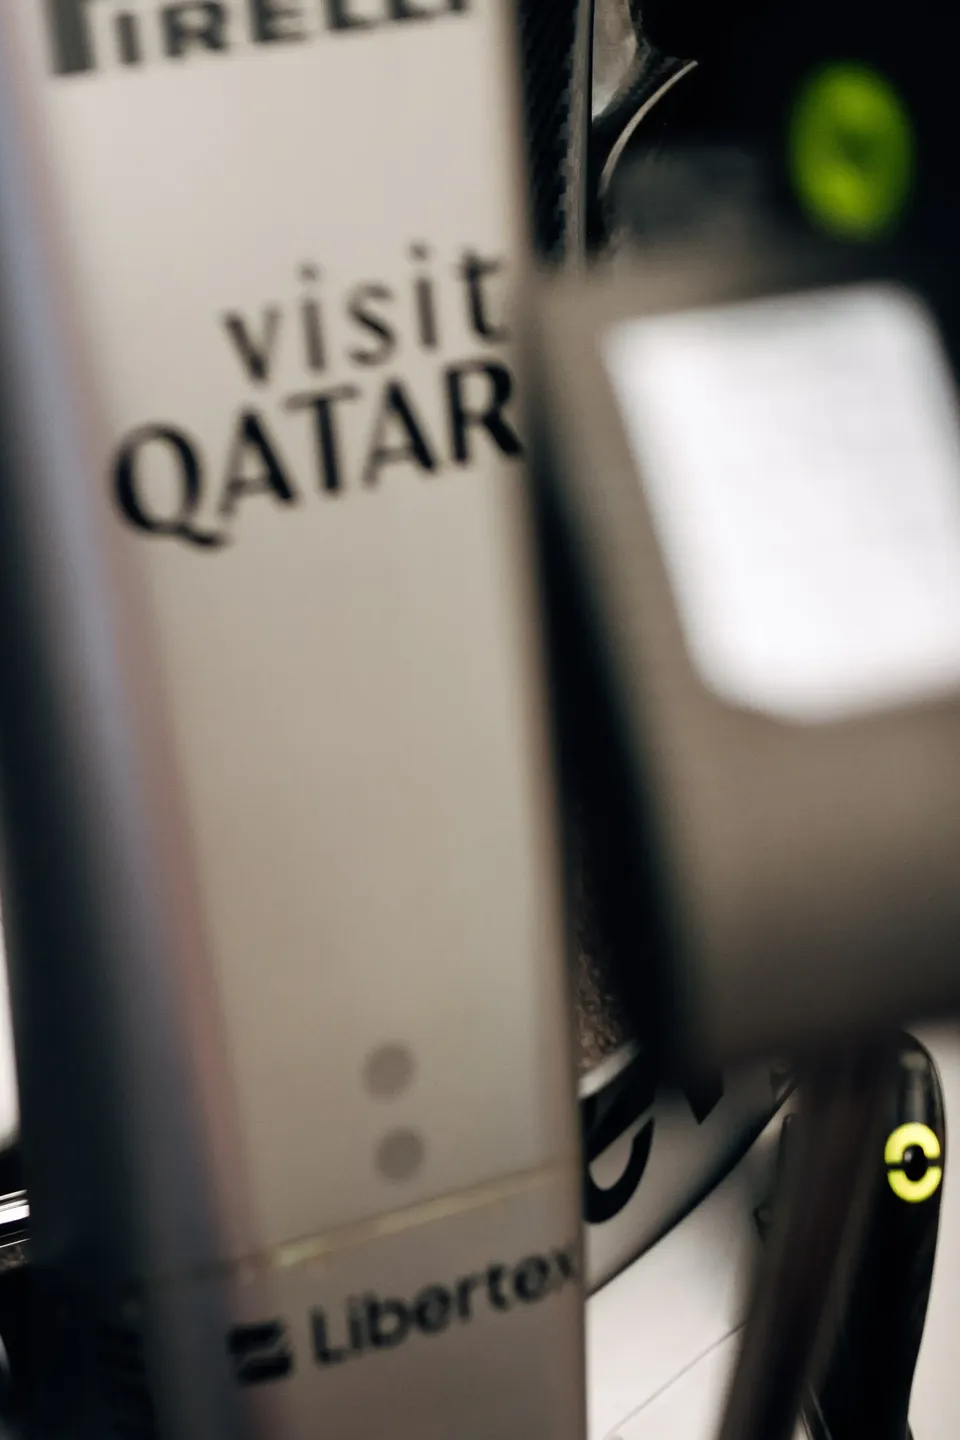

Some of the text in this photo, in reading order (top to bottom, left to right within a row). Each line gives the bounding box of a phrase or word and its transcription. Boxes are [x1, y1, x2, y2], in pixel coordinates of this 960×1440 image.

[47, 0, 470, 77] IREL
[221, 236, 508, 388] visit
[111, 357, 524, 554] QATAR
